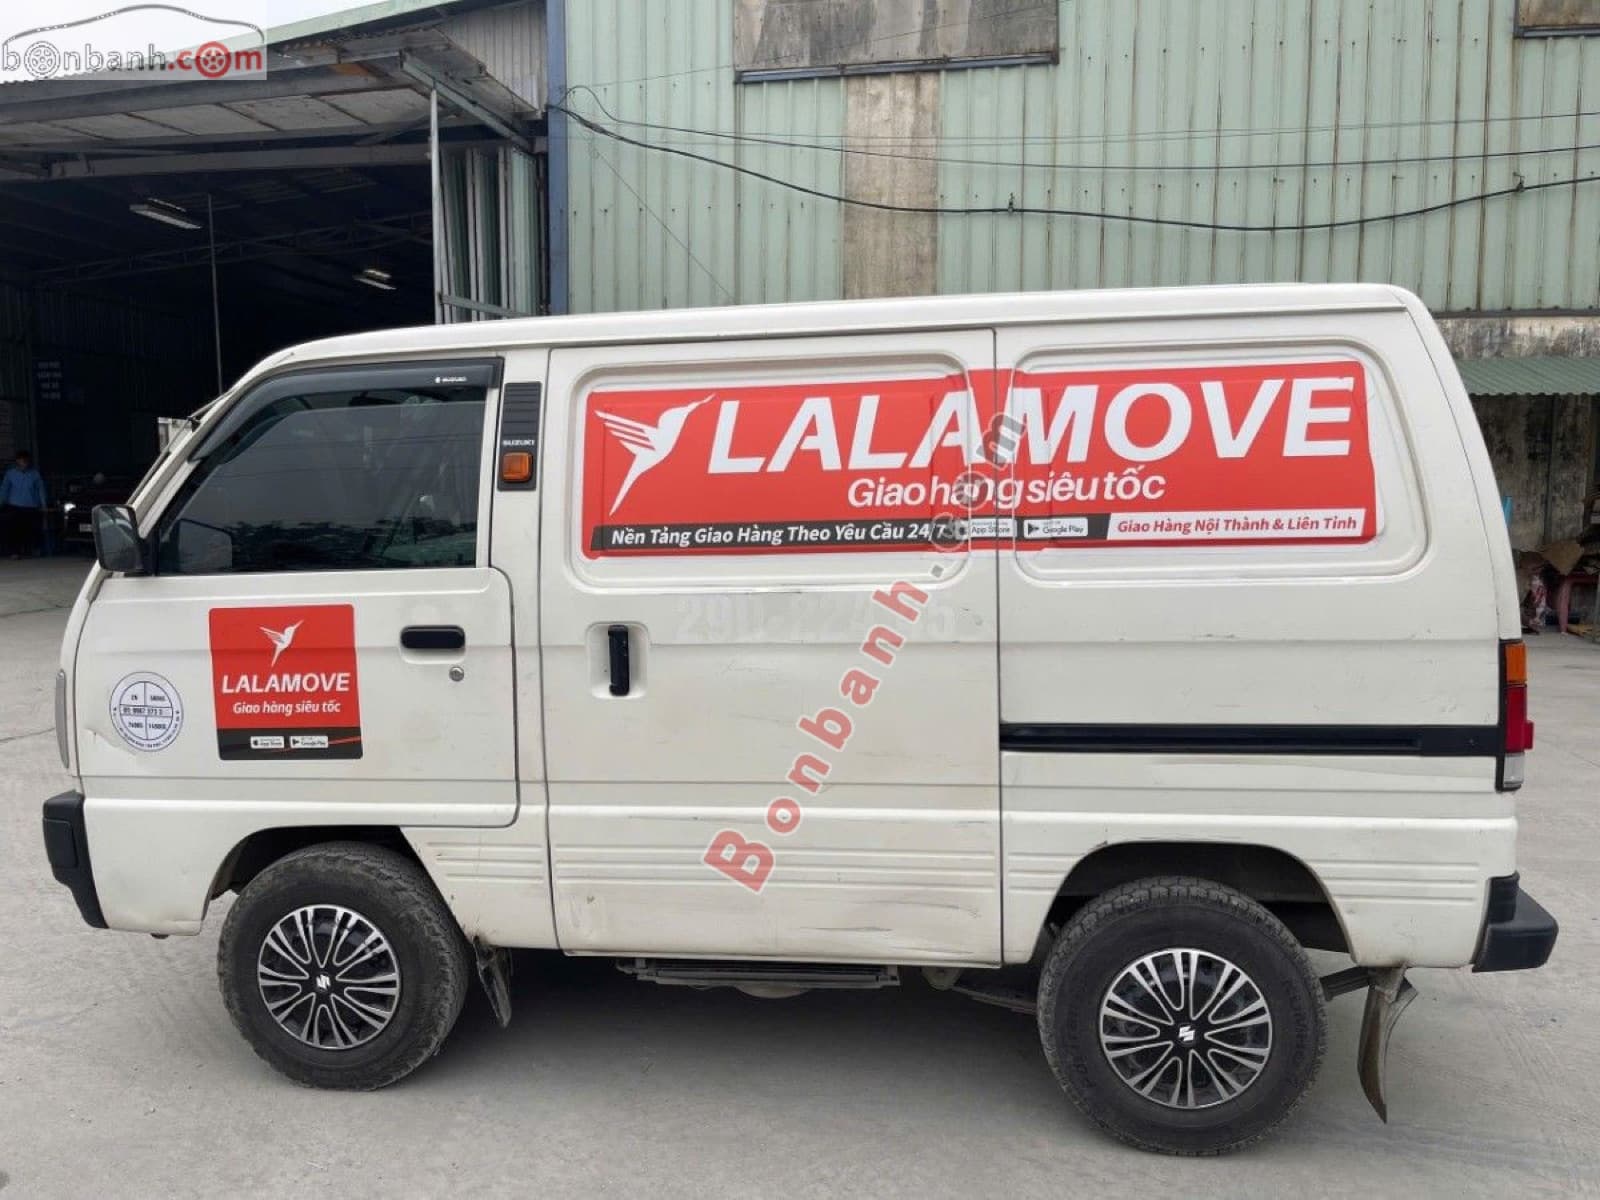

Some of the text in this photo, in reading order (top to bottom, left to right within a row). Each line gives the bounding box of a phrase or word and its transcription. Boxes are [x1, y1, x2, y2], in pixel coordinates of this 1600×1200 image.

[707, 376, 1355, 475] LALAMOVE
[847, 476, 927, 508] Giao
[1026, 470, 1098, 504] siêu
[1103, 464, 1166, 501] tốc
[611, 521, 947, 548] Nền Tảng Giao Hàng Theo Yêu Cầu 24/7
[1117, 519, 1150, 533] Giao
[1153, 517, 1192, 535] Hàng
[1194, 517, 1220, 535] Nội
[1223, 515, 1270, 531] Thành
[1272, 517, 1284, 531] &
[1288, 515, 1320, 530] Liên
[221, 672, 351, 694] LALAMOVE
[232, 699, 341, 717] Giao hàng siêu tốc
